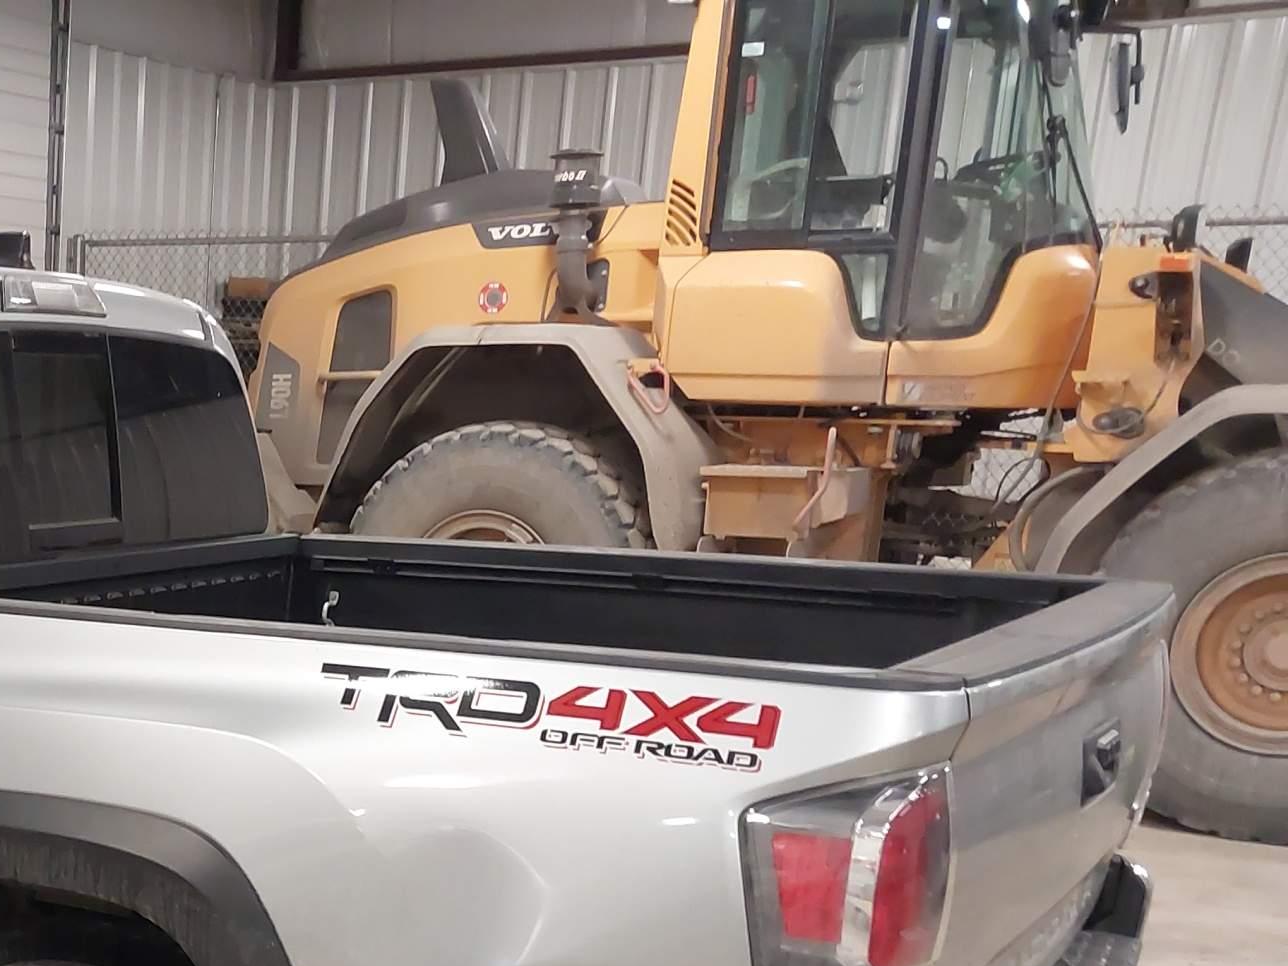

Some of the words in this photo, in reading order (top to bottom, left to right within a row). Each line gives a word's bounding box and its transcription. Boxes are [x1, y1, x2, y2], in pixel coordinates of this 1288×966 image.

[488, 222, 560, 240] VOL
[321, 663, 543, 734] TRD
[539, 729, 626, 754] OFF
[634, 740, 760, 771] ROAD
